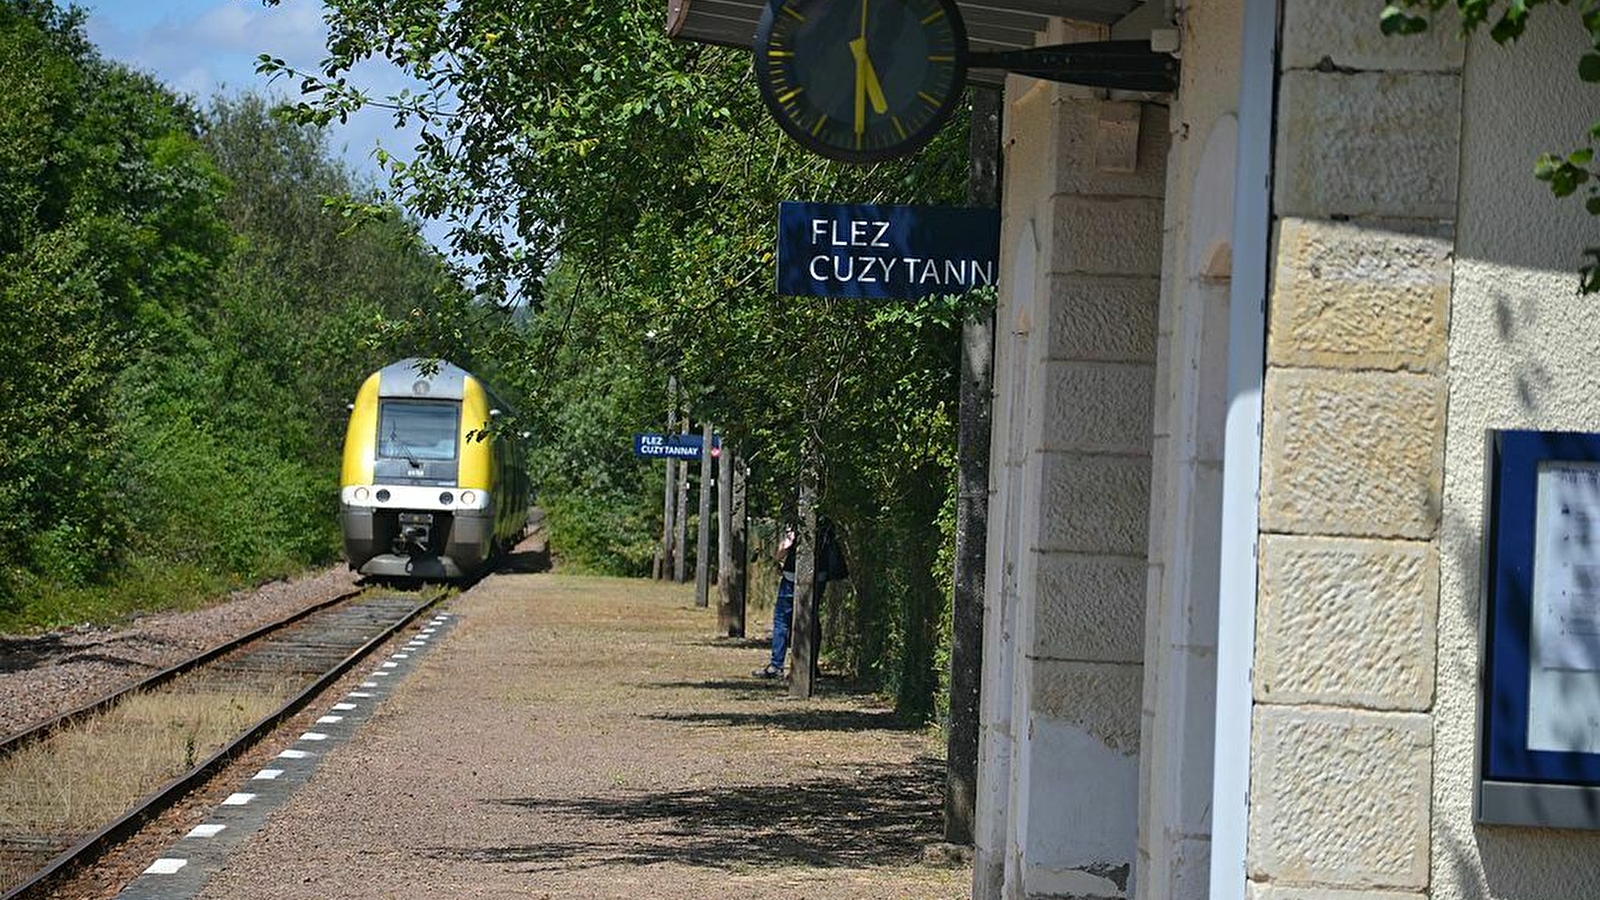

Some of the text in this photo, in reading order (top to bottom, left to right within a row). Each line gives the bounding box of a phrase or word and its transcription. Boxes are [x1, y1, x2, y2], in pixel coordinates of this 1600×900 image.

[811, 219, 890, 248] FLEZ
[809, 255, 999, 286] CUZY TANN
[641, 436, 663, 445] FLEZ
